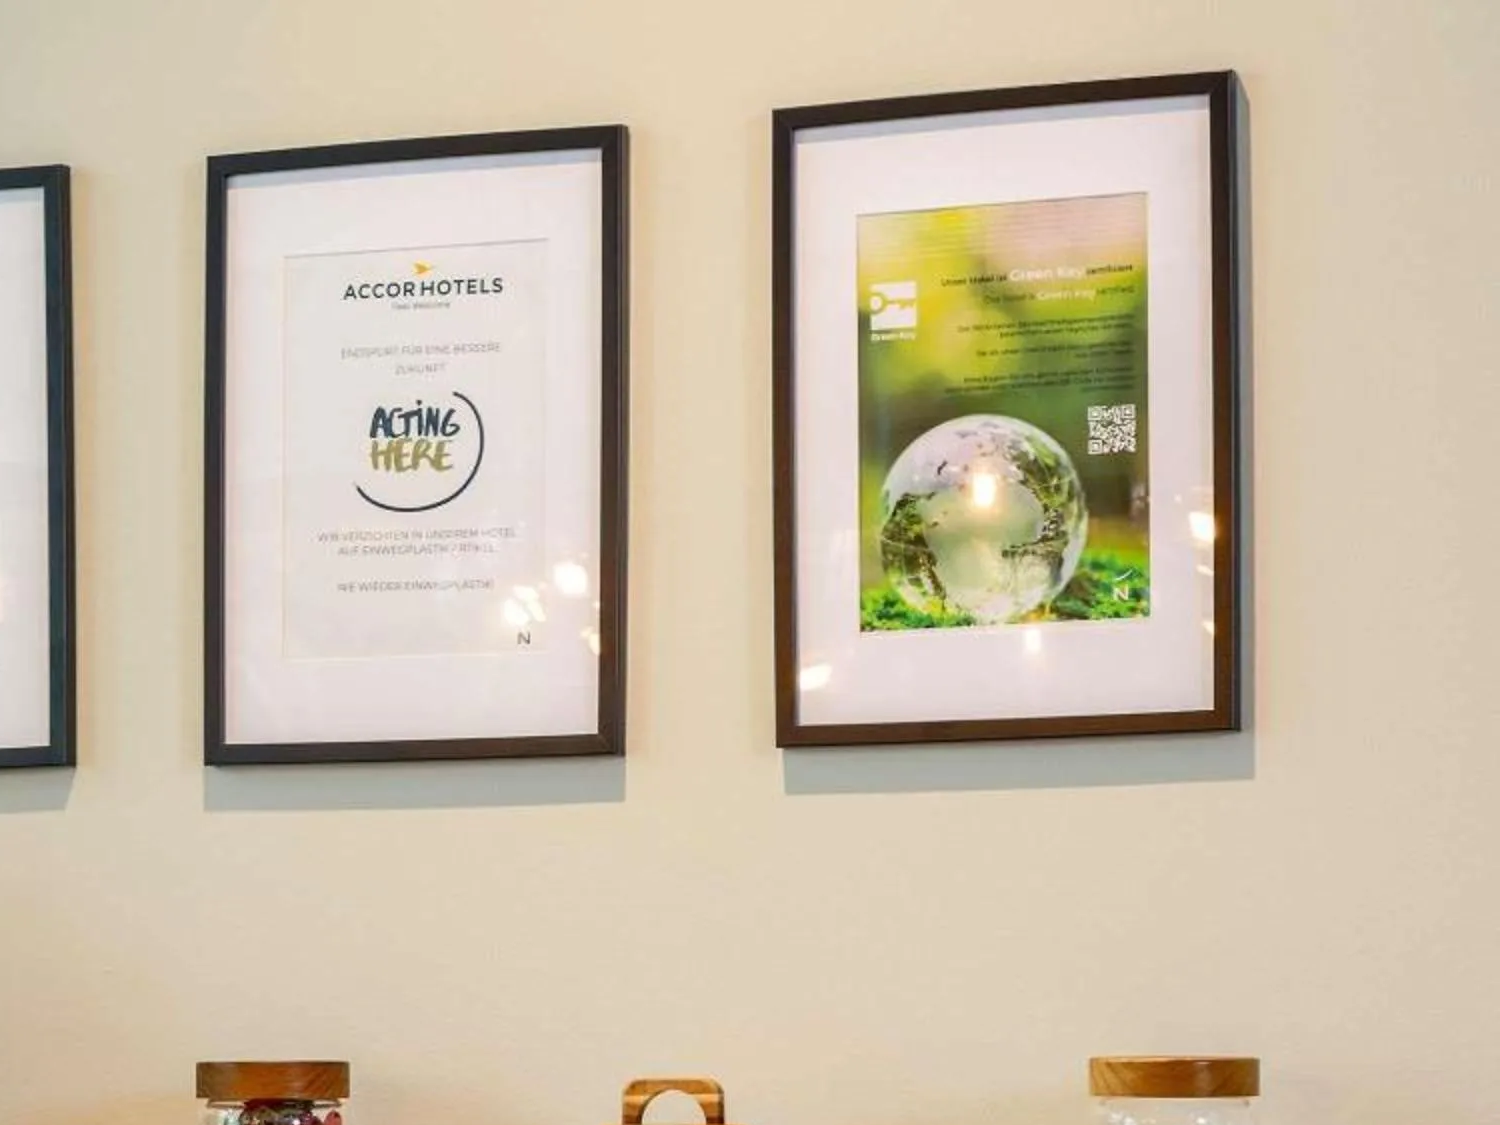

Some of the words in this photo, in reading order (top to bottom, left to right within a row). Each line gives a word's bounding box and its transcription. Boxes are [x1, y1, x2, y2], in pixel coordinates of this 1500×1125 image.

[1009, 268, 1054, 283] Green
[1056, 265, 1086, 280] Key
[369, 399, 460, 438] ACTING
[369, 438, 454, 473] HERE
